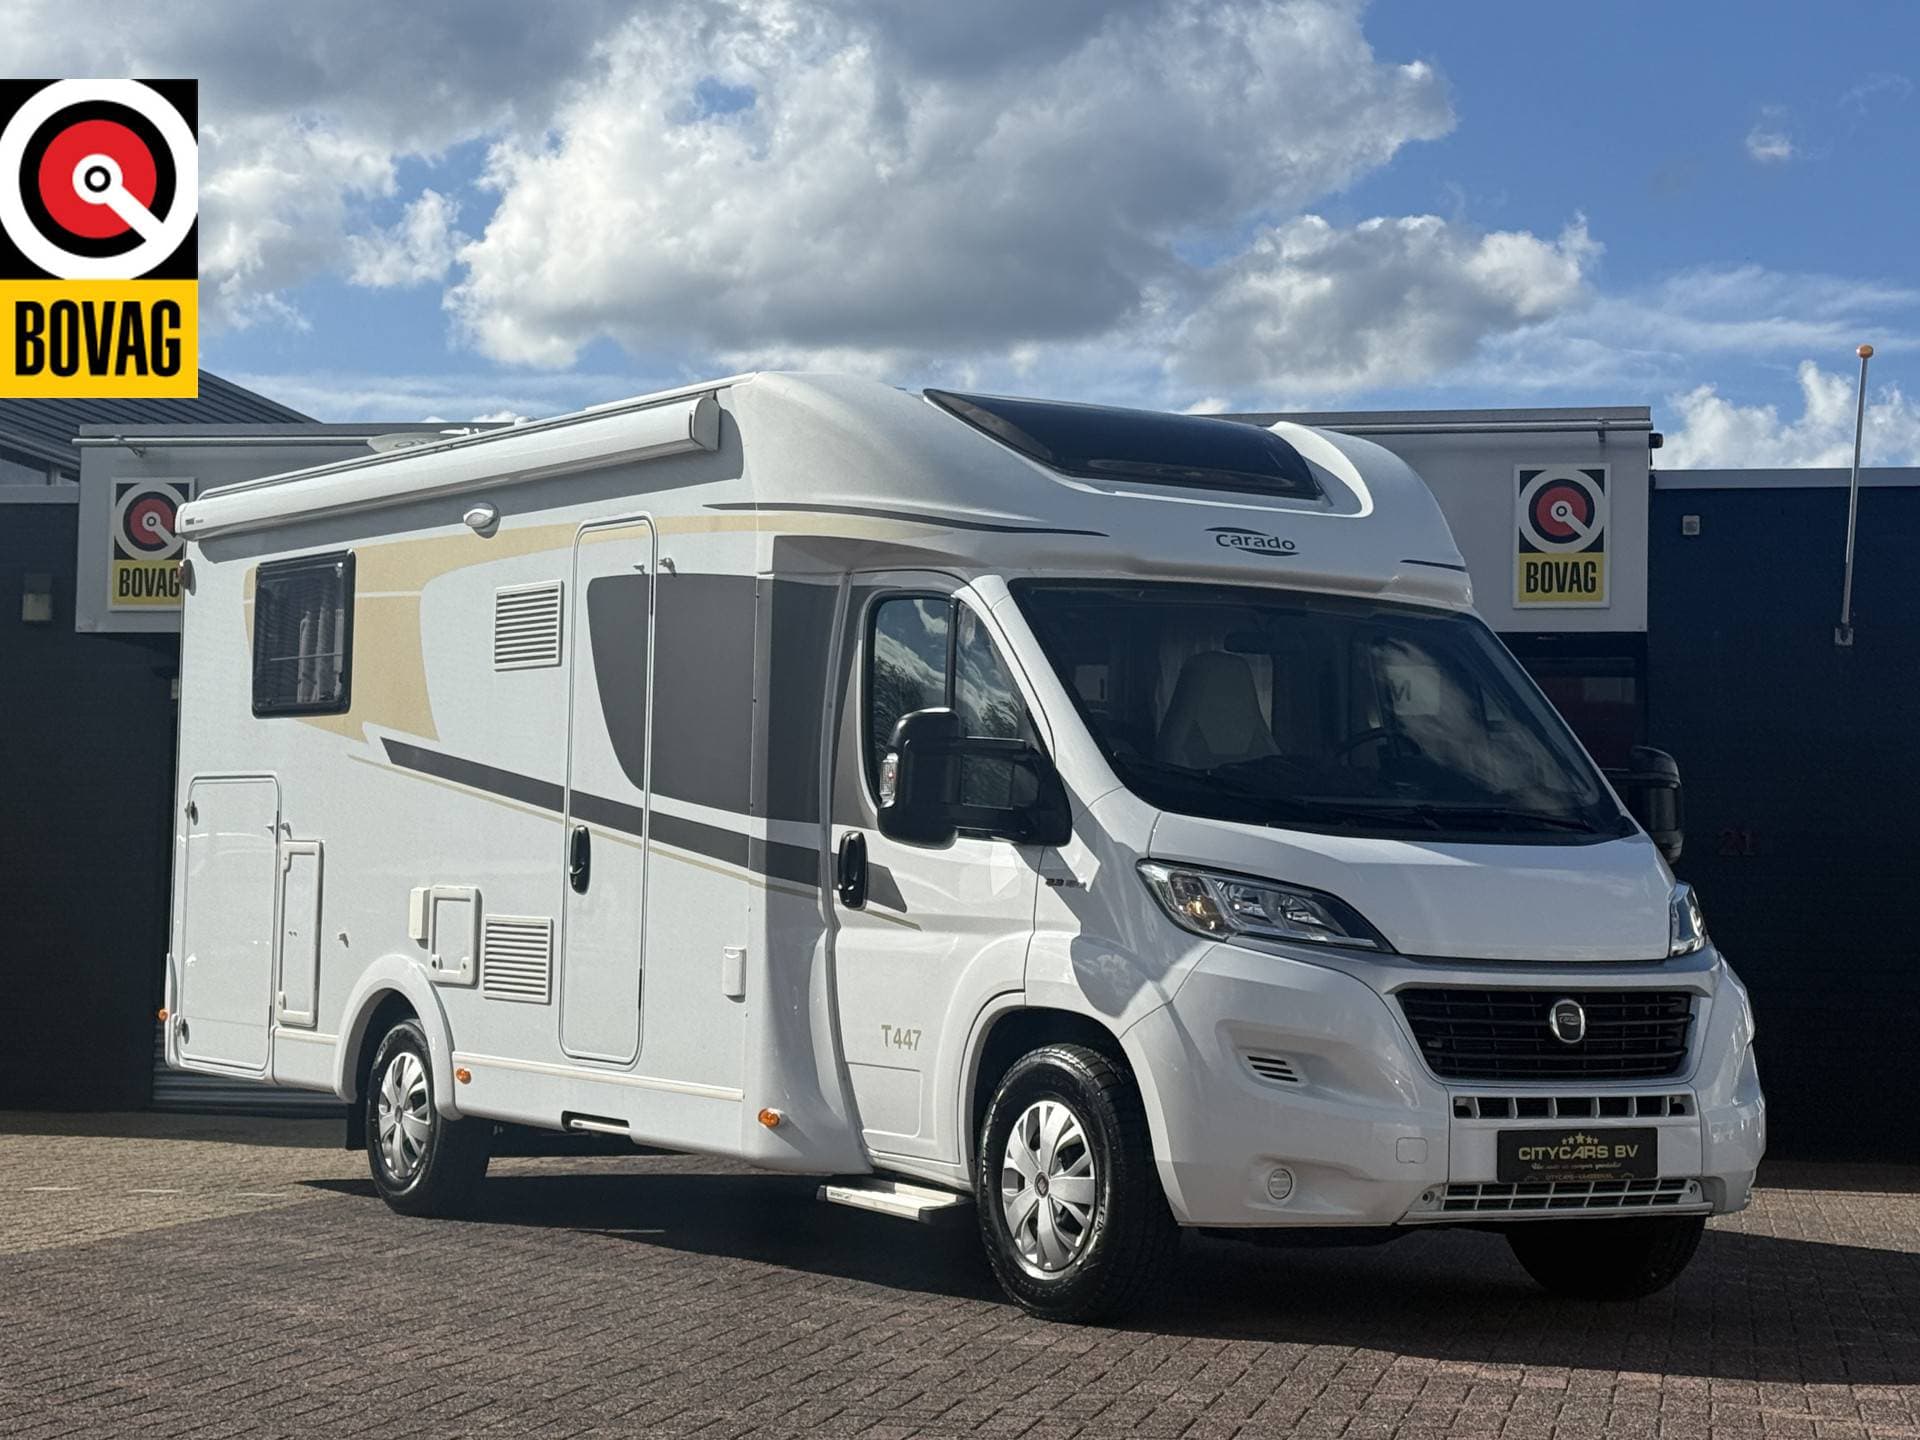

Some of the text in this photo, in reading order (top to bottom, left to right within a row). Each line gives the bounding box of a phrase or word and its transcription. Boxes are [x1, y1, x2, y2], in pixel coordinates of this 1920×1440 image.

[1215, 534, 1296, 550] Carado
[118, 567, 180, 597] BOVAG
[1525, 561, 1597, 593] BOVAG
[881, 1024, 922, 1051] T447
[1518, 1144, 1639, 1161] CITYCARS BV
